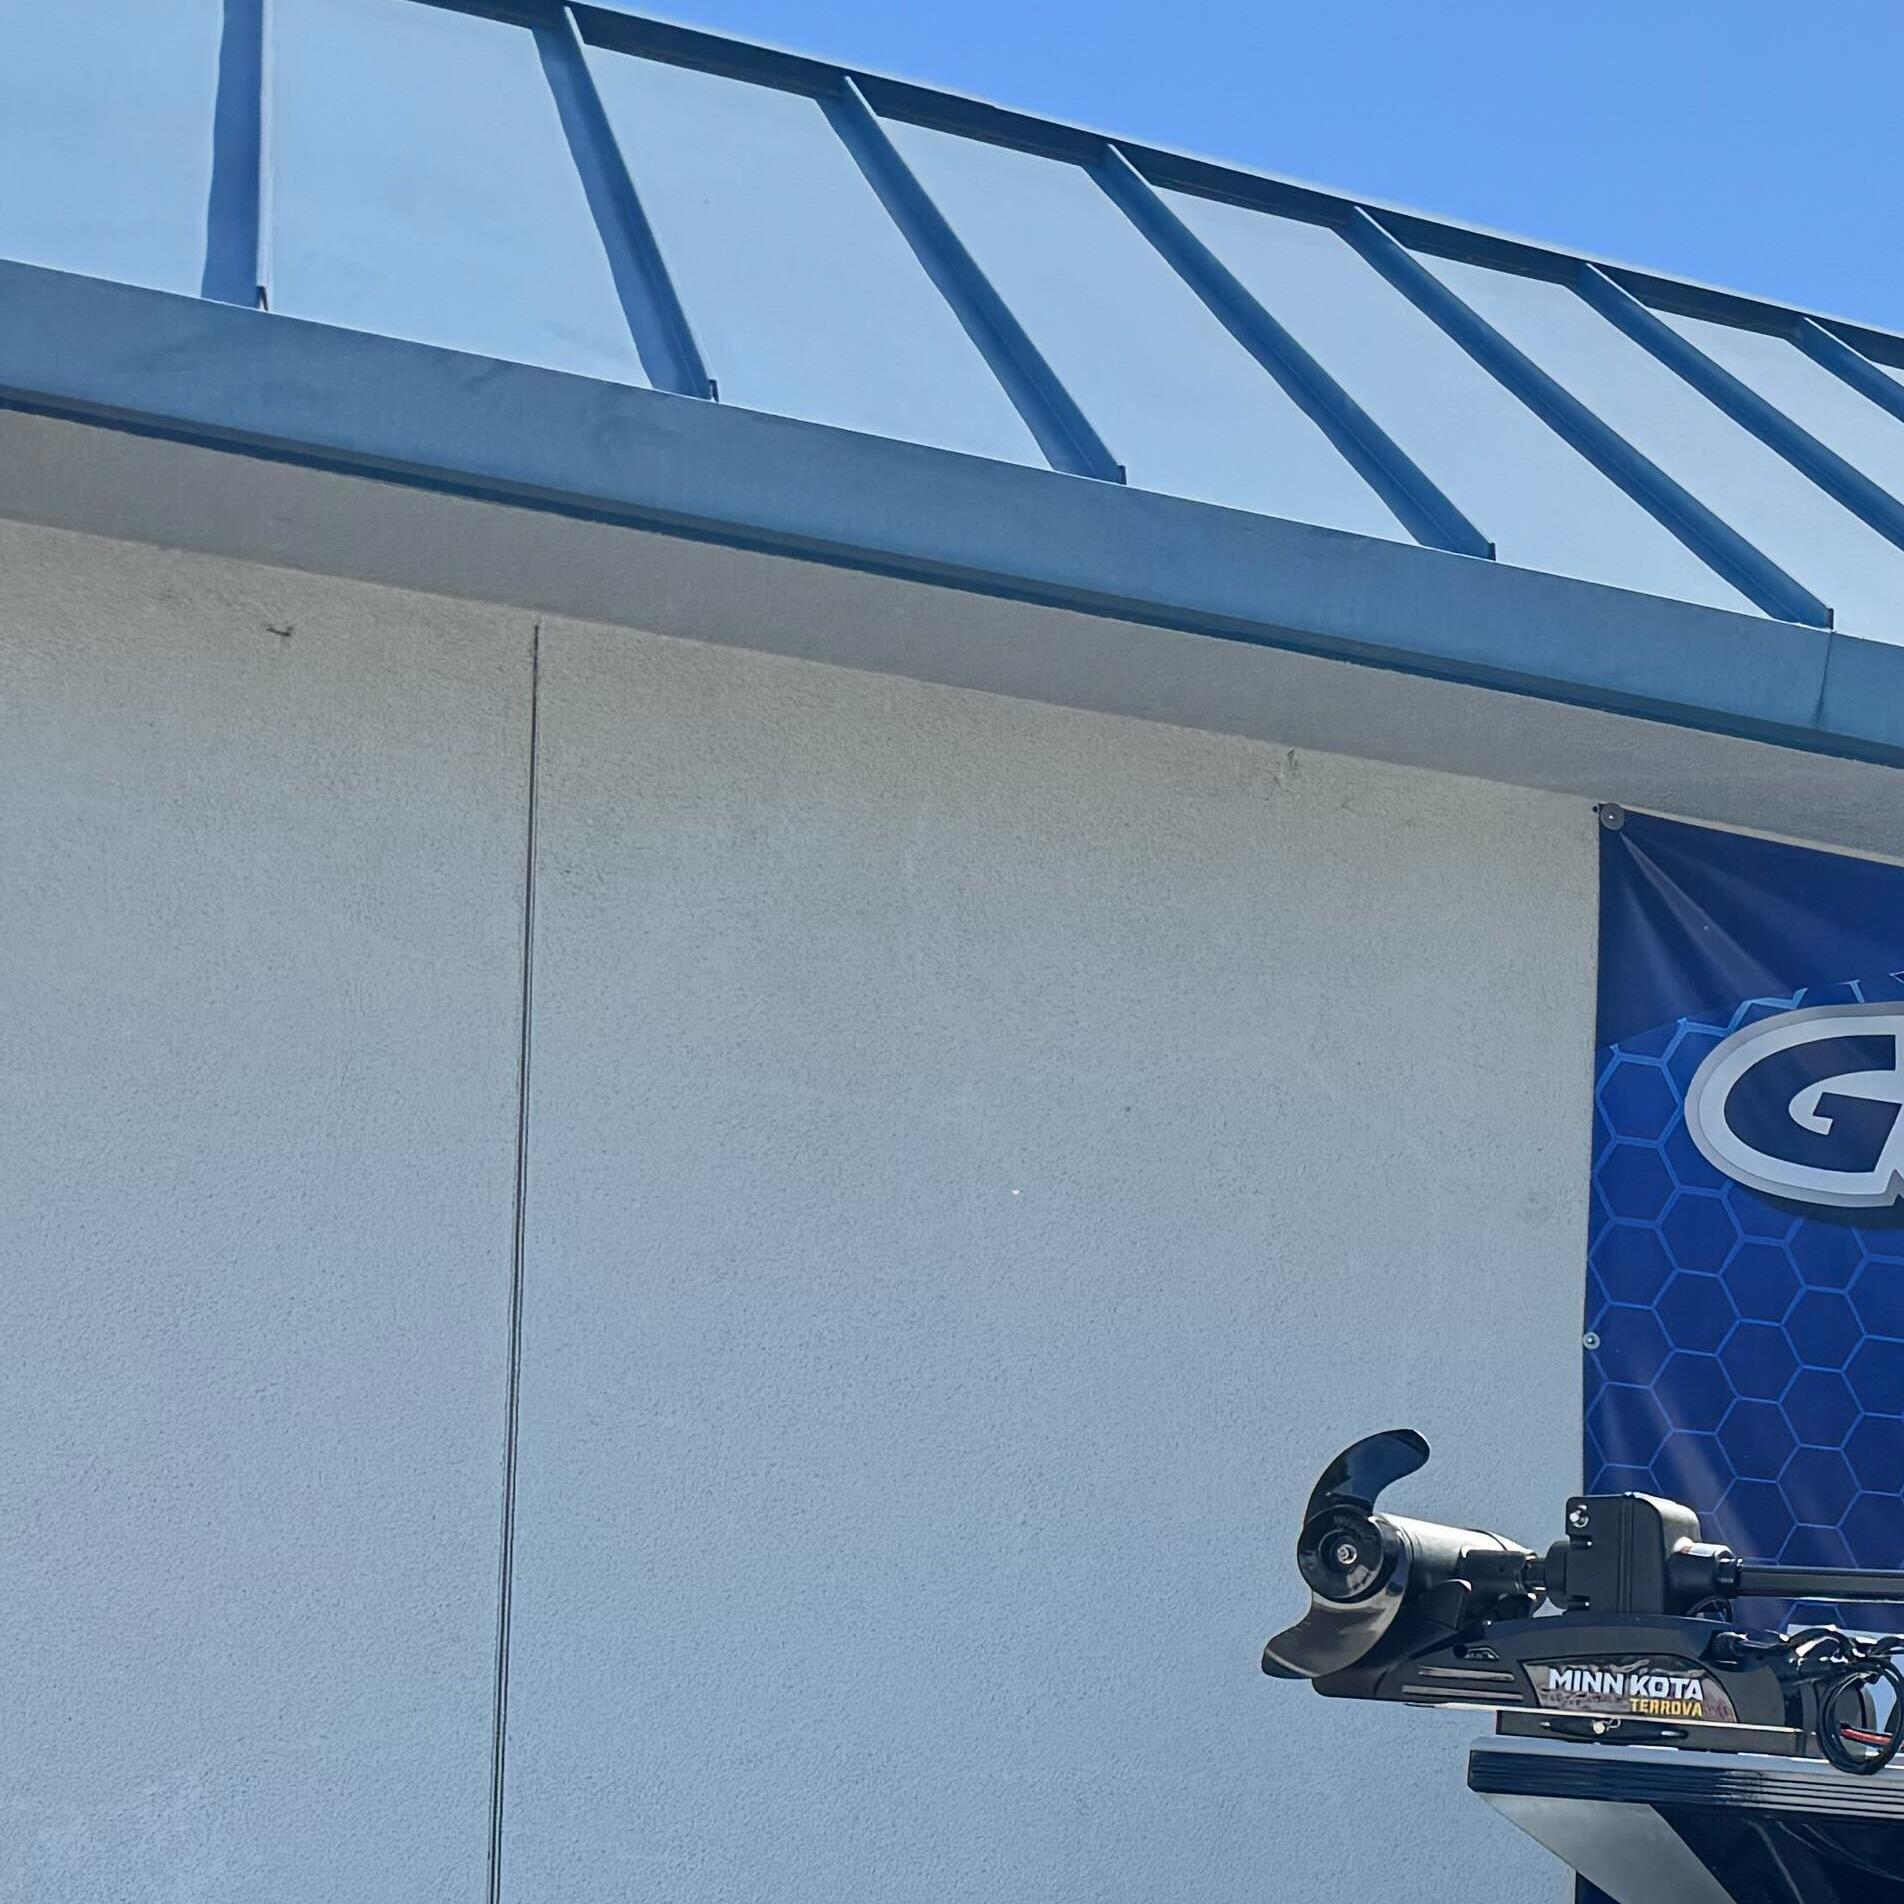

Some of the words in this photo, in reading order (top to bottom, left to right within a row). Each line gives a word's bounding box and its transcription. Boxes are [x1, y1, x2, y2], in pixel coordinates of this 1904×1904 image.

[1549, 1668, 1625, 1696] MINN
[1629, 1674, 1704, 1701] KOTA
[1629, 1698, 1703, 1717] TERROVA
